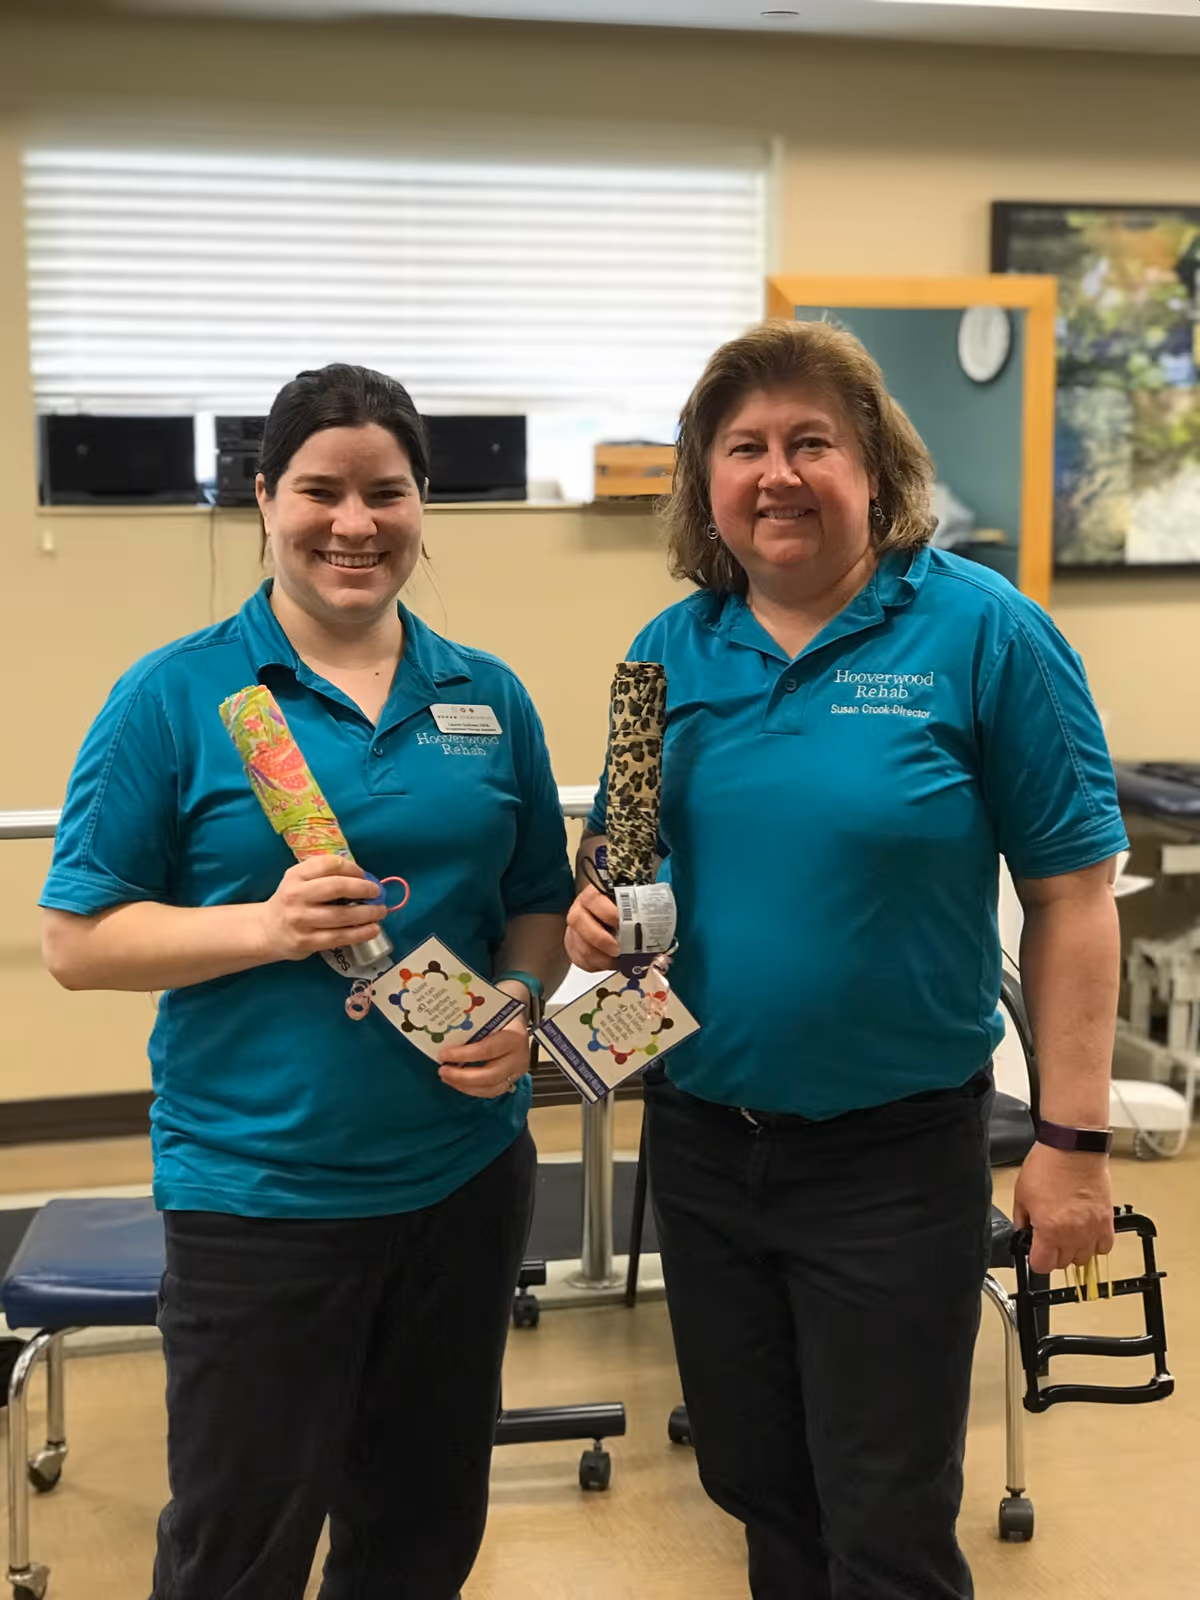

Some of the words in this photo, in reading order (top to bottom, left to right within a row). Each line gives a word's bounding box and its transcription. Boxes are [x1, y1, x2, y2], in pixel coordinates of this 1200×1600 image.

[834, 669, 934, 686] Hooverwood
[855, 685, 908, 698] Rehab
[831, 704, 859, 714] Susan
[862, 704, 931, 718] Crook-Director
[441, 744, 486, 755] Rehab
